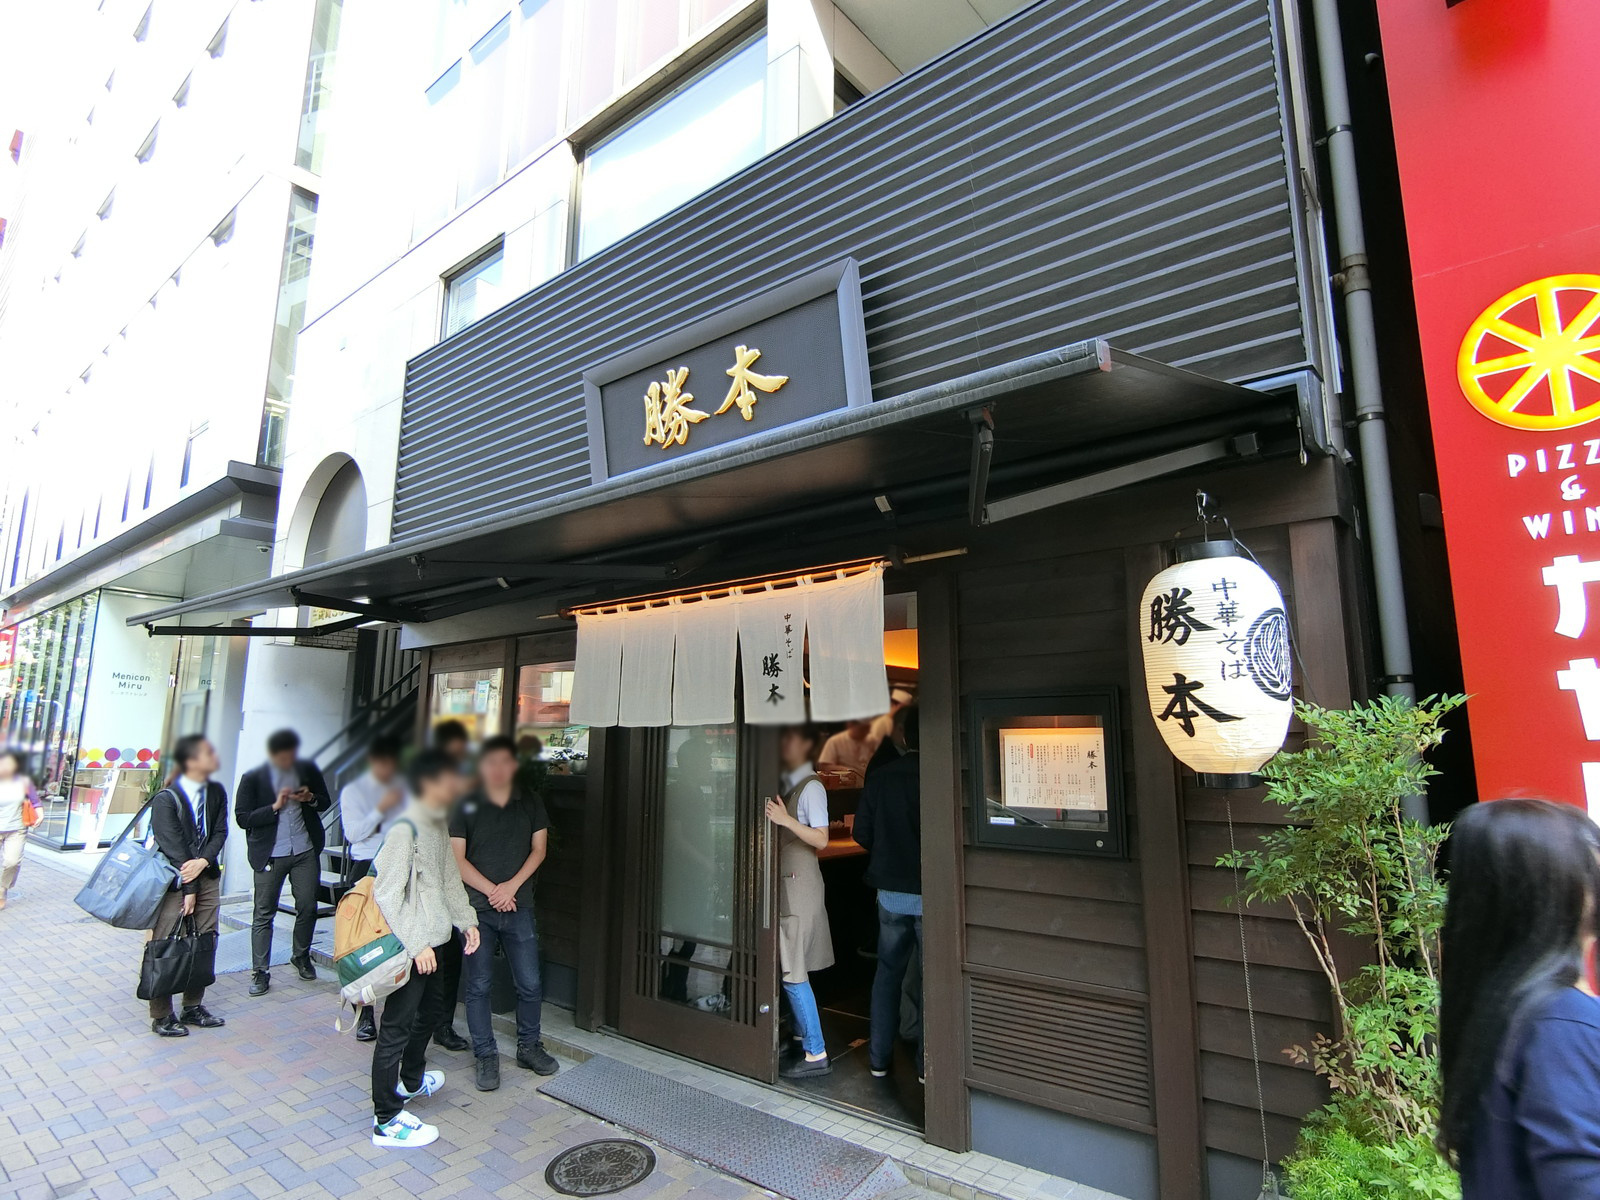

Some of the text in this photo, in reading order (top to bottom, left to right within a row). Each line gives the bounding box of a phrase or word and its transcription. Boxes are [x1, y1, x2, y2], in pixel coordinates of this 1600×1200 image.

[642, 344, 790, 450] 勝本
[1560, 474, 1587, 501] &
[783, 612, 794, 660] 中華そば
[1212, 577, 1248, 681] 中華そば
[112, 672, 151, 682] Menicon
[118, 681, 143, 690] Miru
[1147, 587, 1245, 738] 勝本
